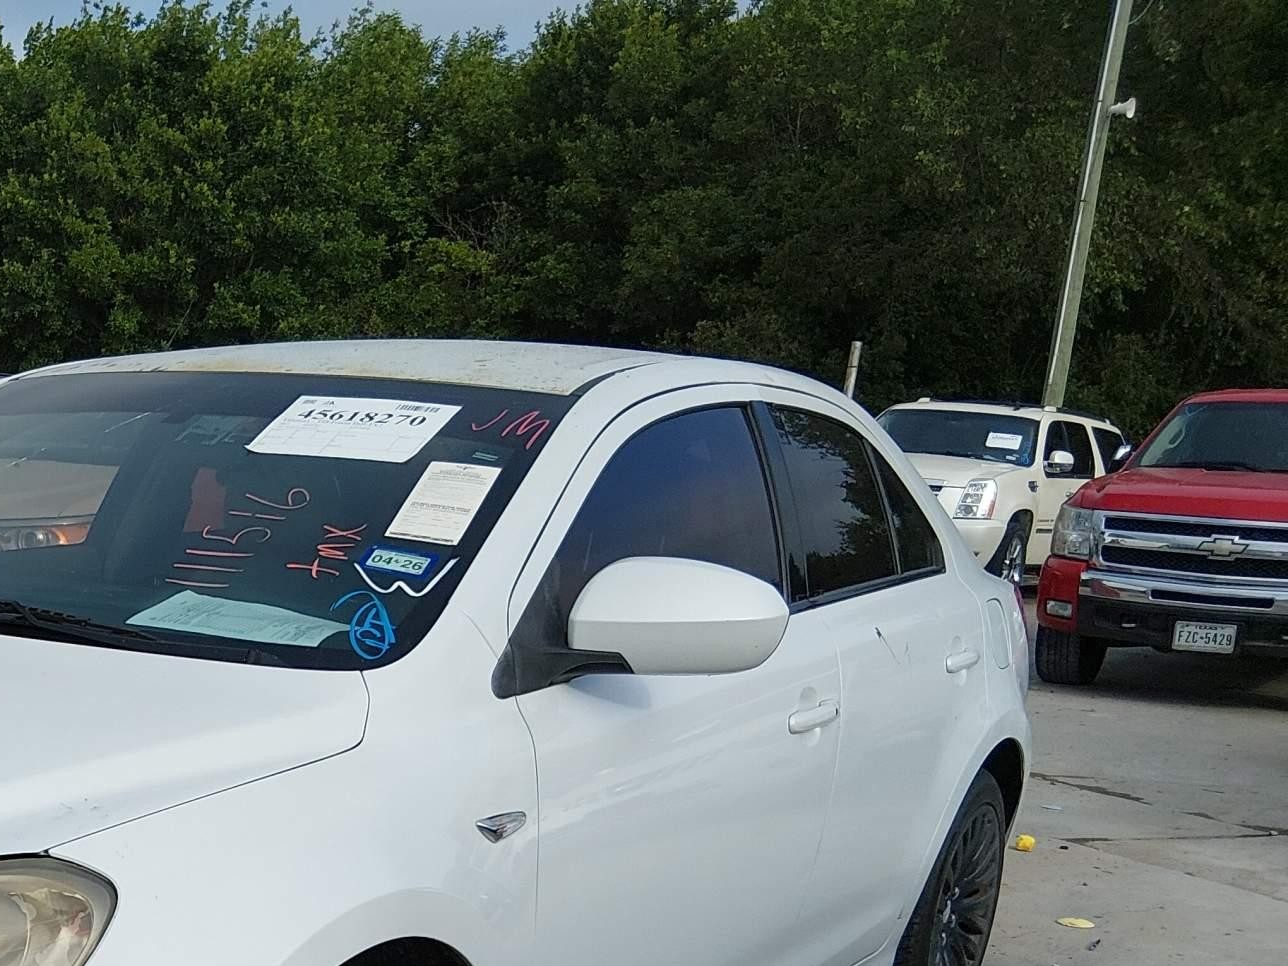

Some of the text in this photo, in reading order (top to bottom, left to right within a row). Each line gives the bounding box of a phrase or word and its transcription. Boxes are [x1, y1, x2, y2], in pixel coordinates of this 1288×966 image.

[297, 409, 427, 427] 45618270
[371, 554, 394, 565] 04
[400, 560, 424, 571] 26
